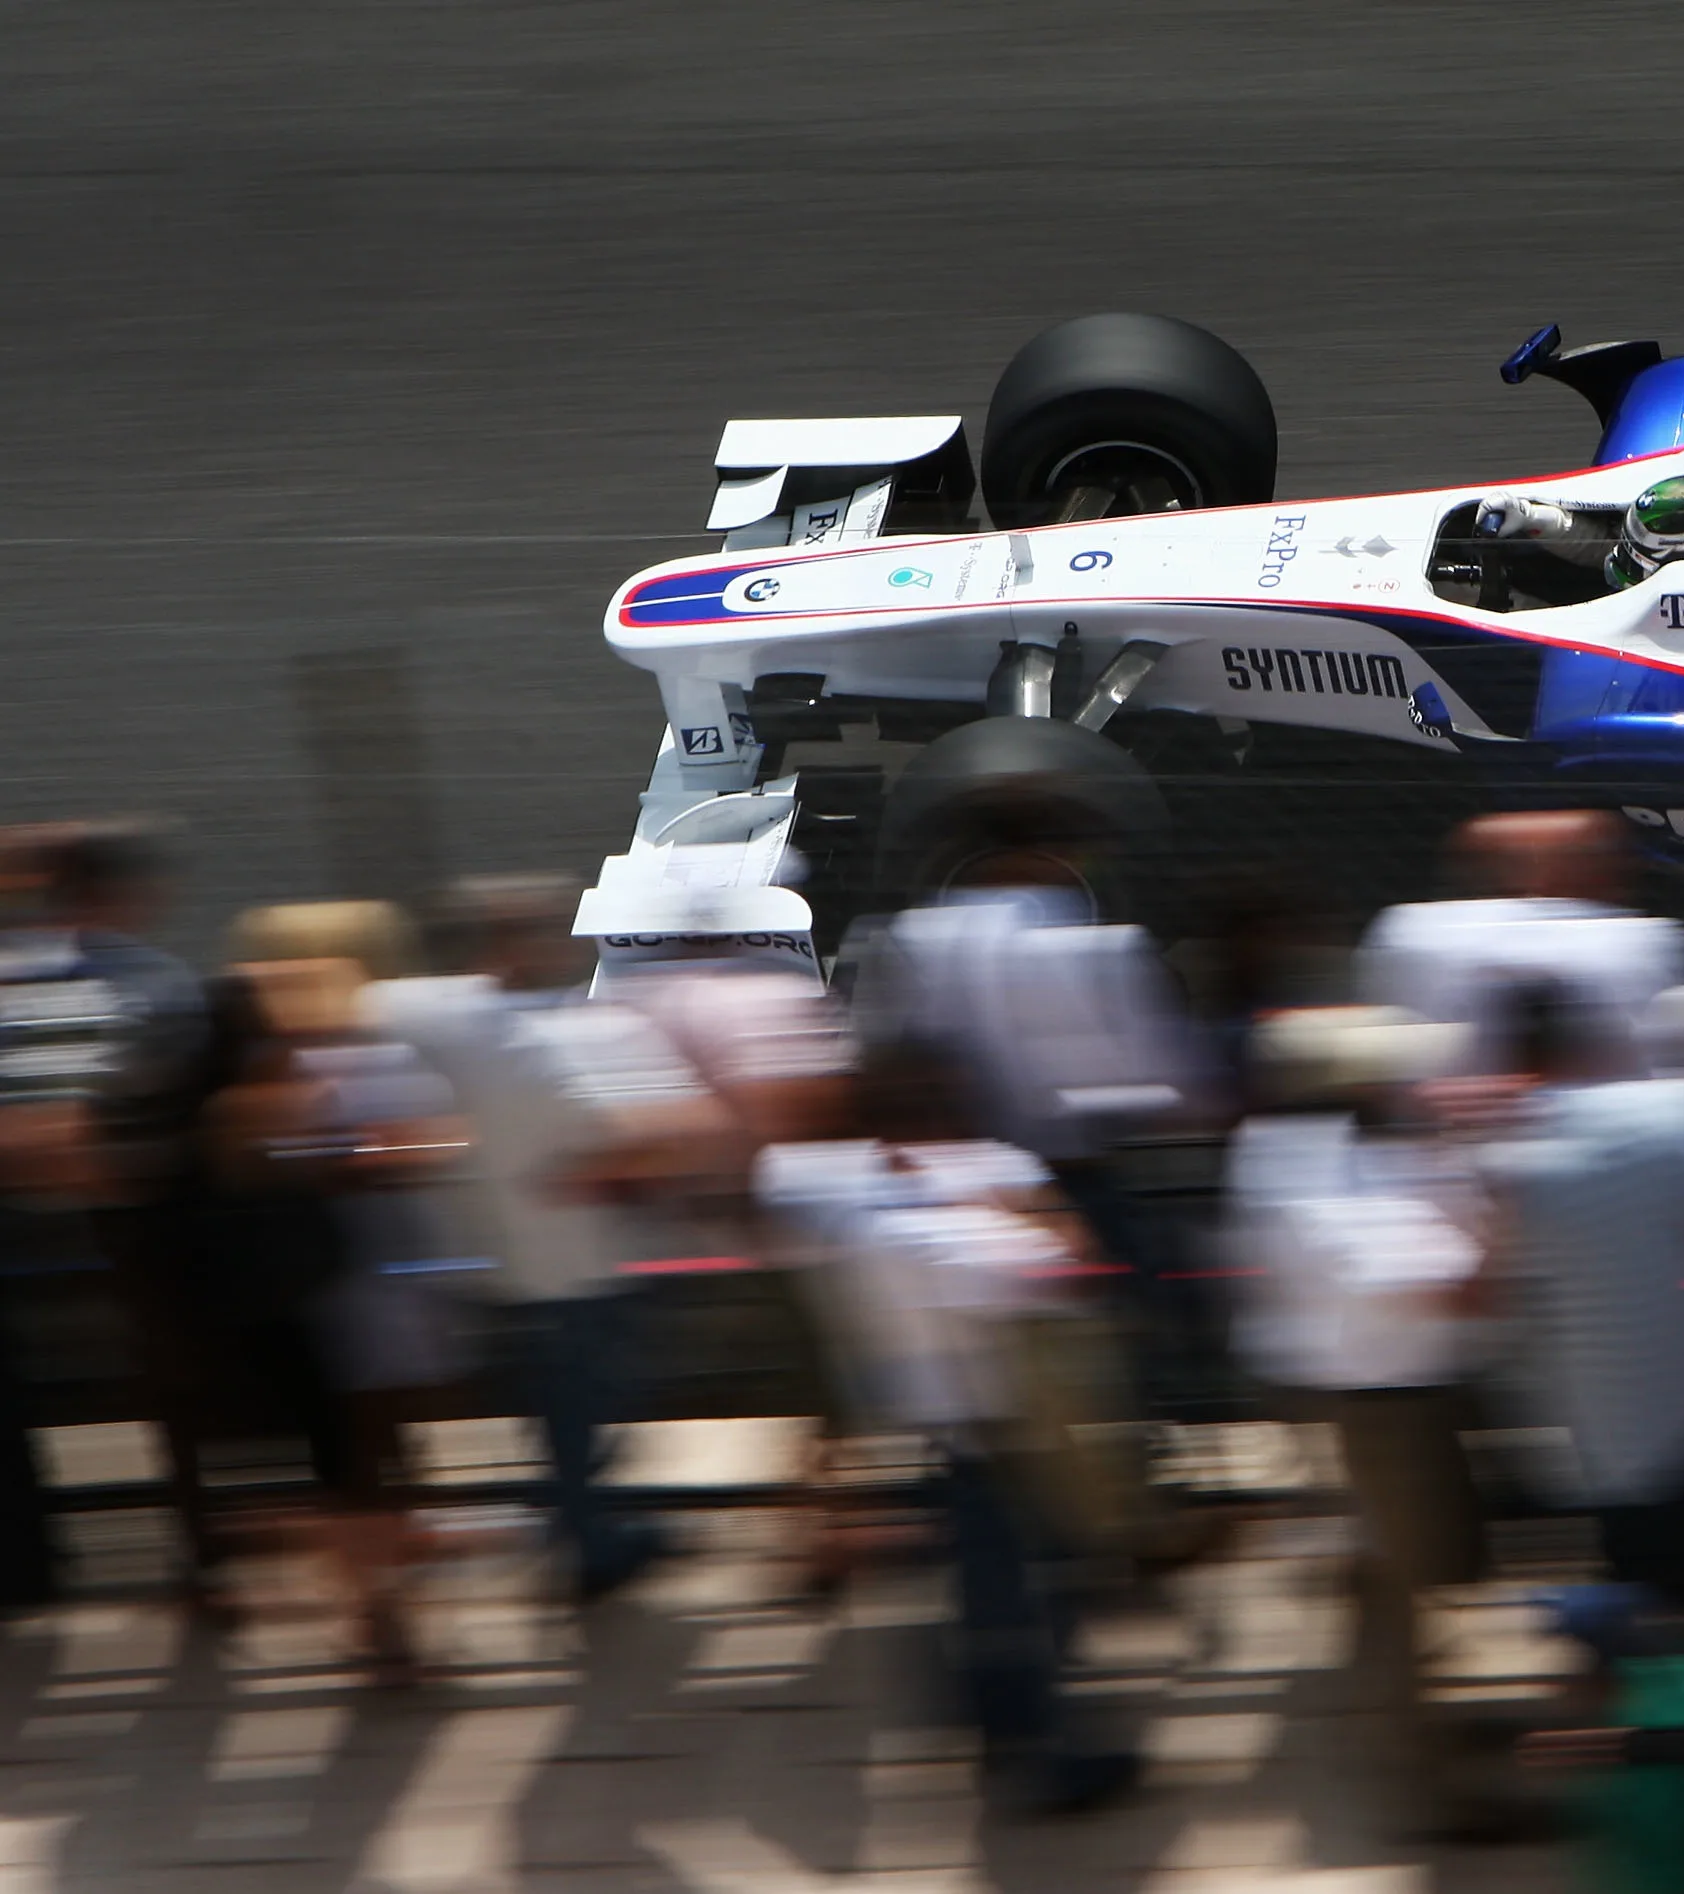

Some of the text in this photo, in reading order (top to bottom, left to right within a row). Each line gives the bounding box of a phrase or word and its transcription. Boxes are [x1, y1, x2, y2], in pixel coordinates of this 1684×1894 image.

[1069, 550, 1113, 572] 6
[1258, 514, 1306, 588] FxPro
[1222, 647, 1408, 699] SYNTIUM
